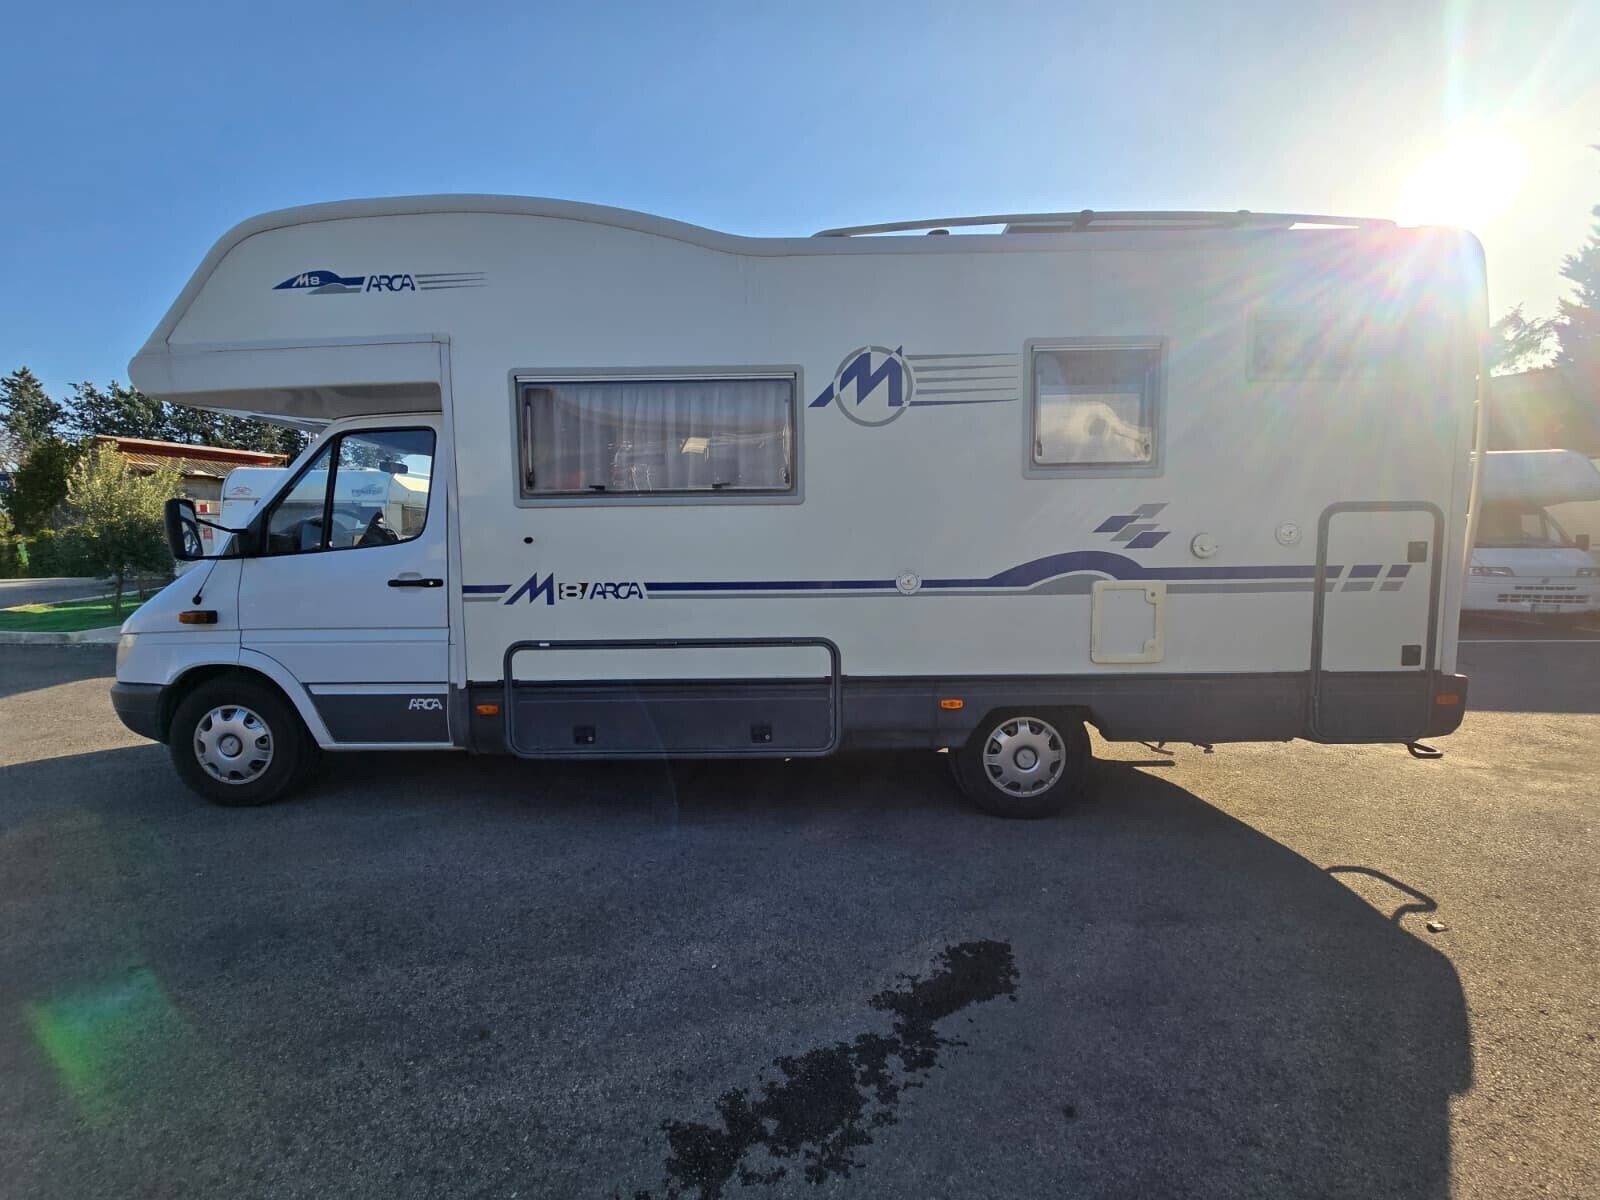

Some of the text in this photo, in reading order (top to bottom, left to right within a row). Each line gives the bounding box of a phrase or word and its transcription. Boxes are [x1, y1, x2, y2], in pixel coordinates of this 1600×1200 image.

[366, 274, 416, 292] ARCA
[589, 582, 643, 600] ARCA
[408, 698, 443, 710] ARCA
